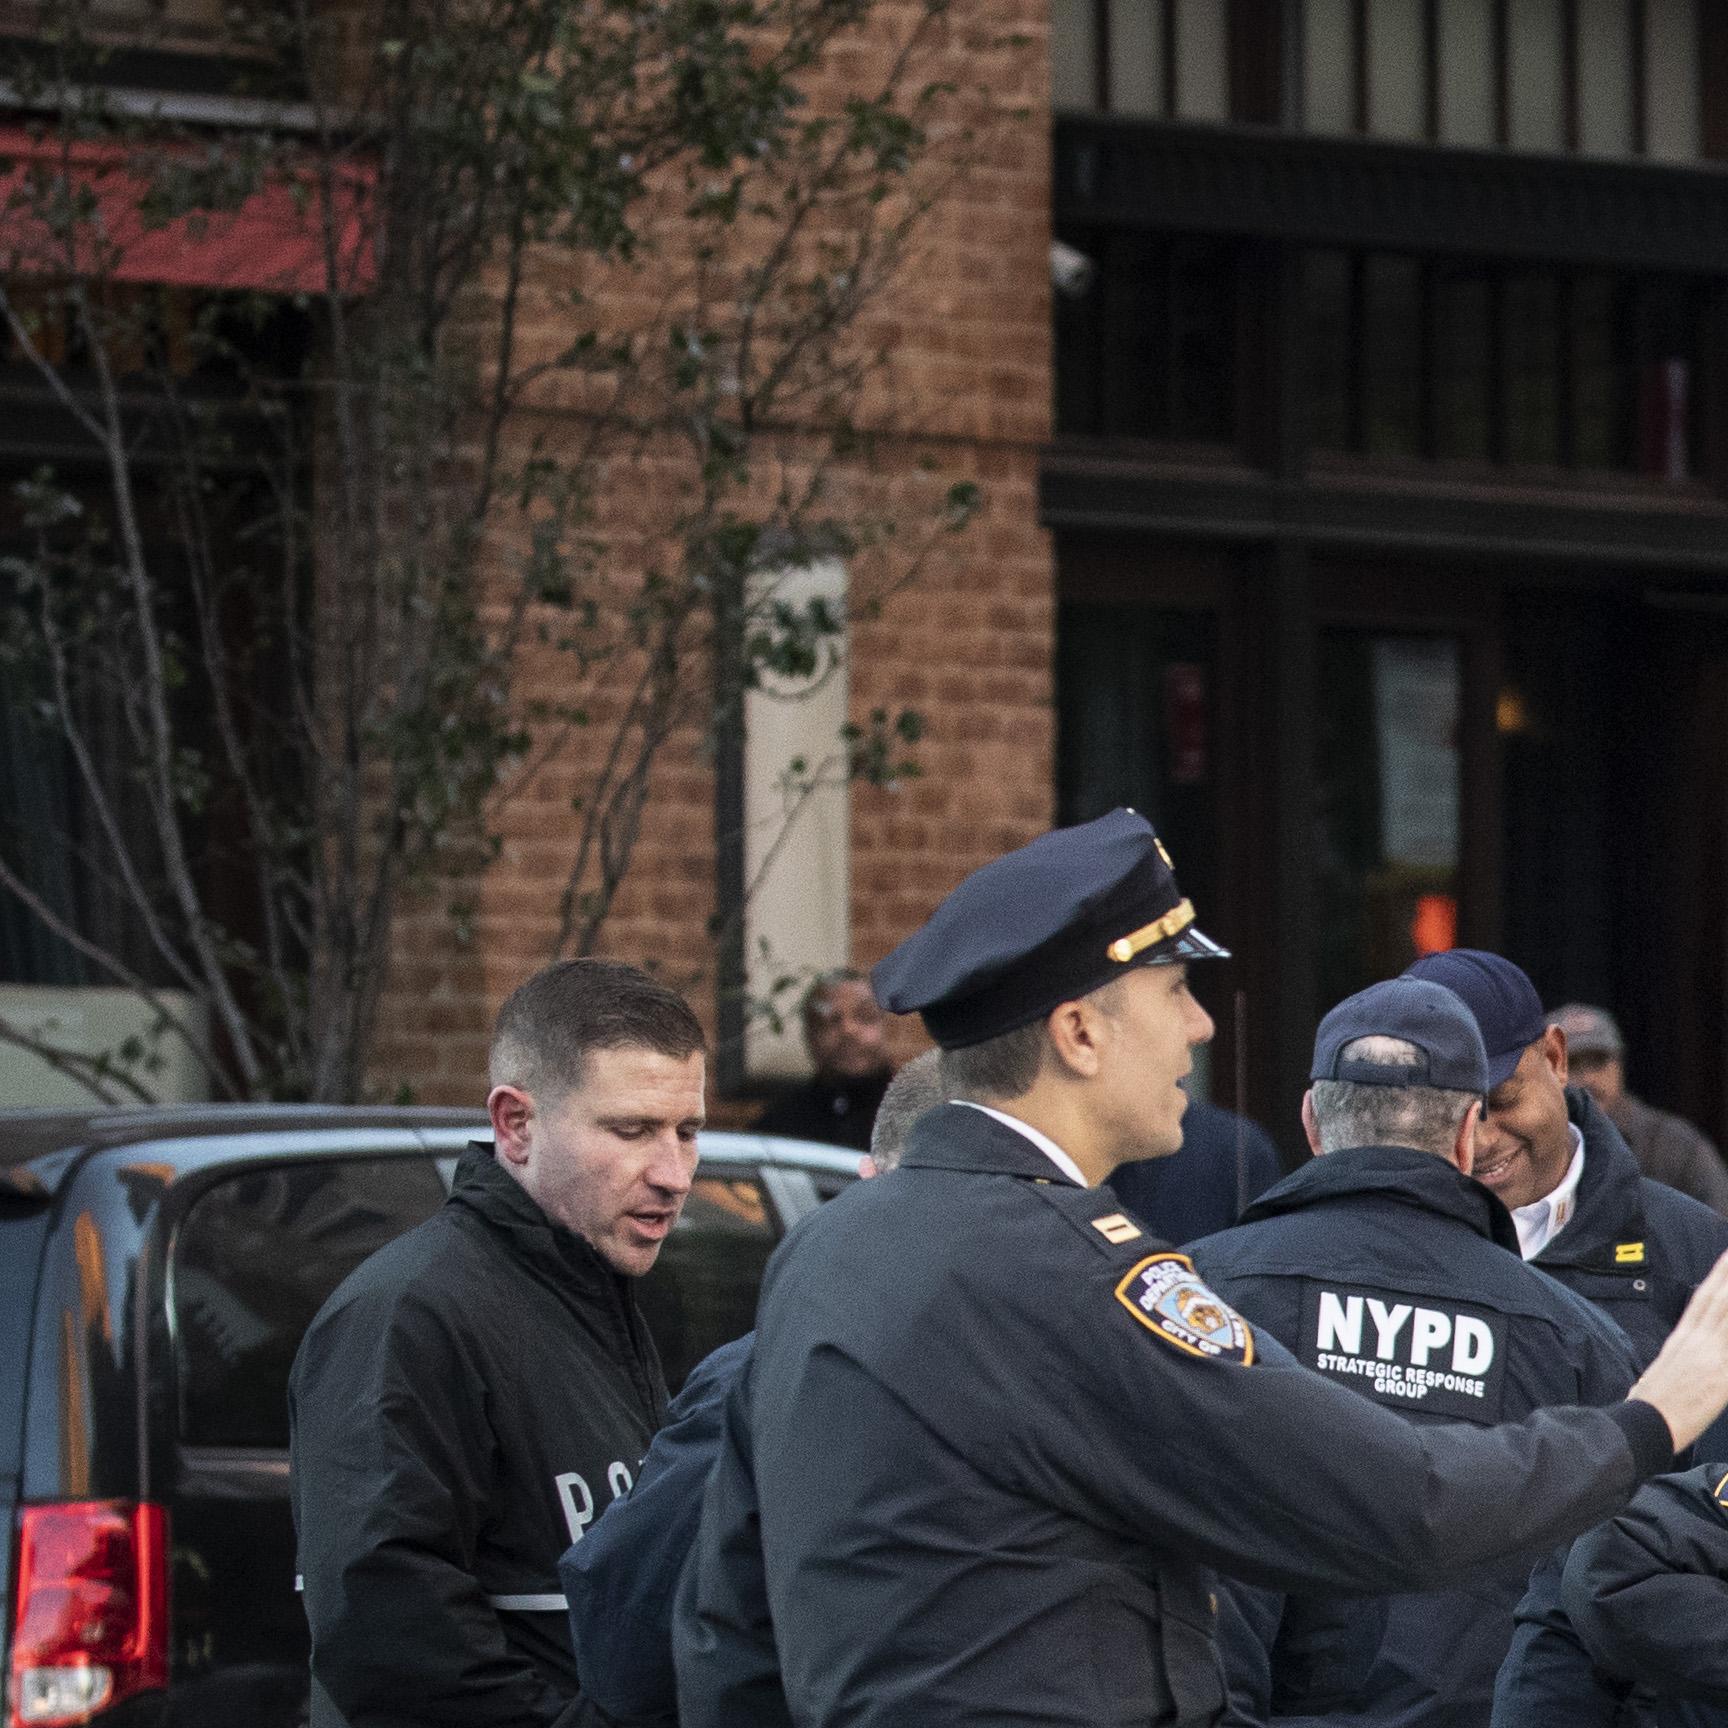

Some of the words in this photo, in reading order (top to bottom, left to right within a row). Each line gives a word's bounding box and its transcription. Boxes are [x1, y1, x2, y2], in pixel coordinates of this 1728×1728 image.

[1161, 1319, 1198, 1344] CITY
[1317, 1292, 1494, 1376] NYPD
[1317, 1353, 1402, 1381] STRATEGIC
[1405, 1367, 1486, 1398] RESPONSE
[1374, 1378, 1428, 1399] GROUP
